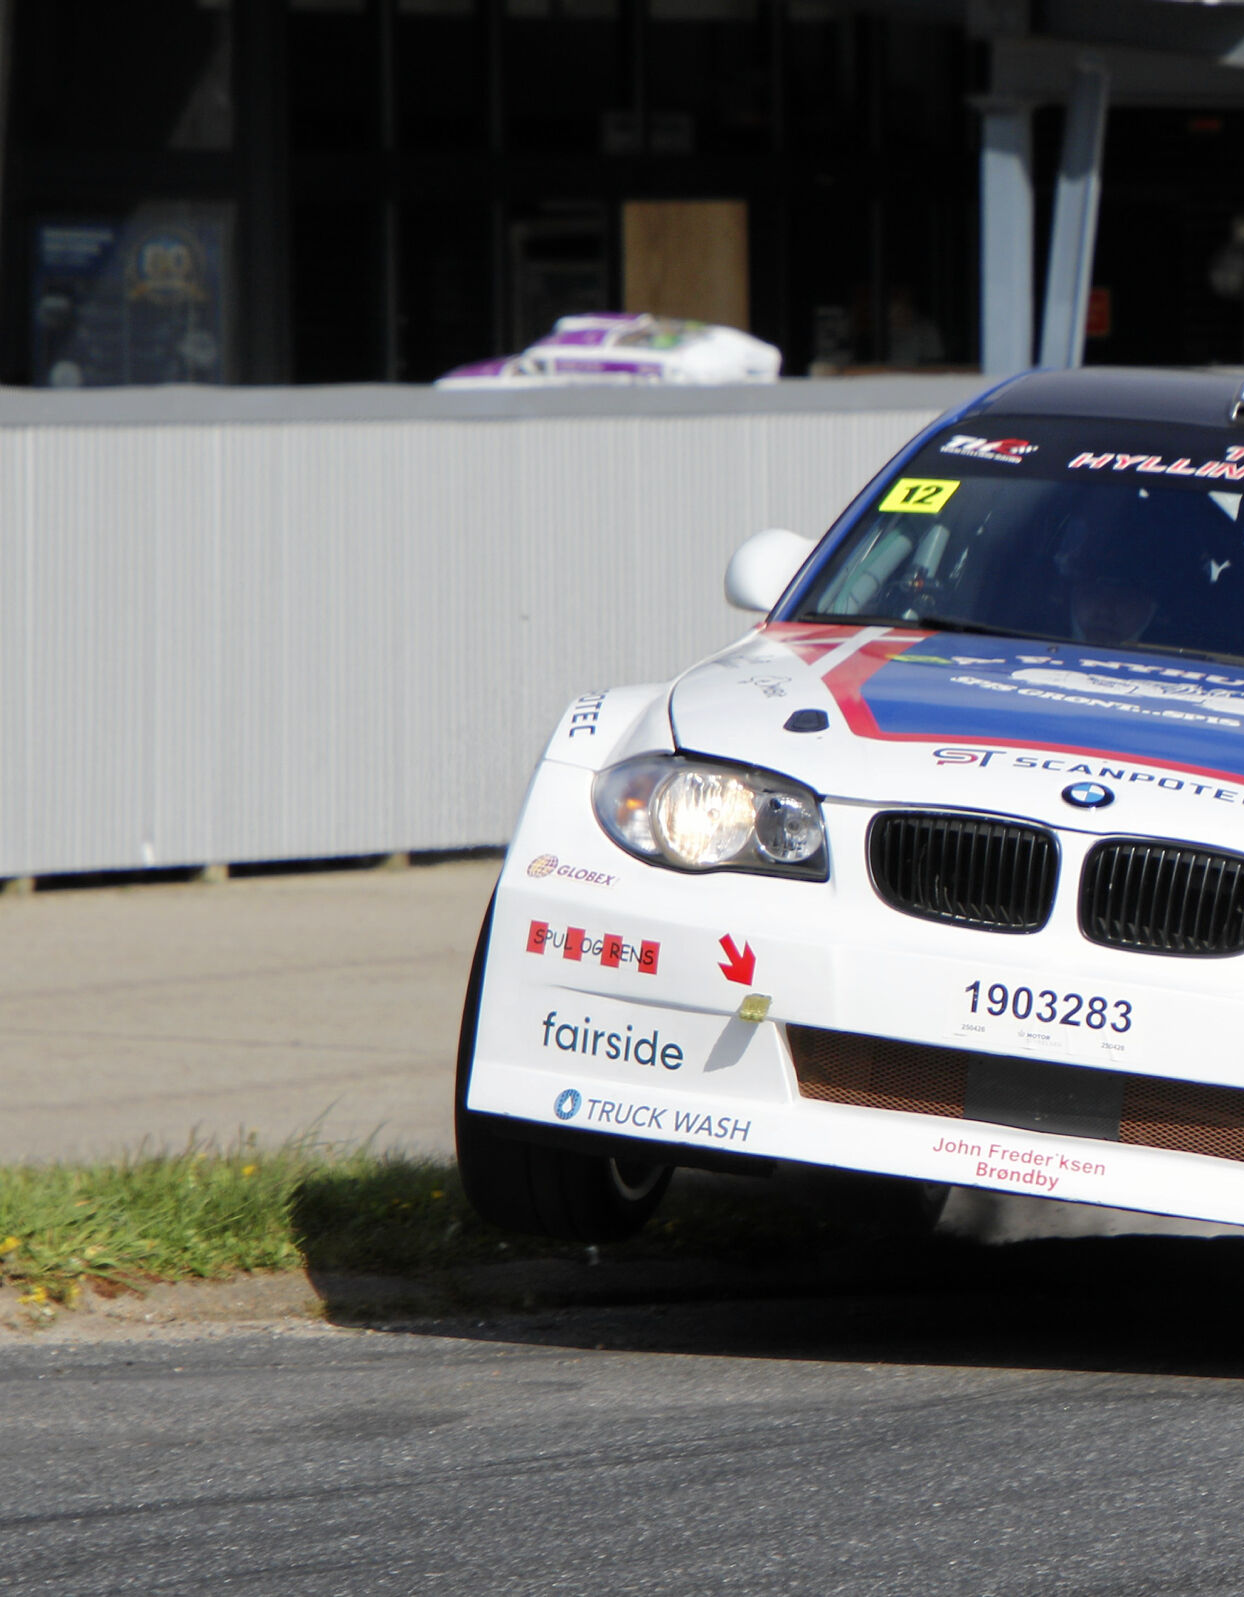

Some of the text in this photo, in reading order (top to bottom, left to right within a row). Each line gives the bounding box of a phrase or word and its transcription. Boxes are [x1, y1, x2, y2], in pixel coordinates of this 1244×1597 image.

[899, 484, 945, 506] 12
[556, 863, 617, 886] GLOBEX
[533, 928, 655, 966] SPUL OG RENS
[964, 979, 1133, 1034] 1903283
[541, 1011, 684, 1070] fairside
[587, 1099, 752, 1142] TRUCK WASH
[932, 1137, 1107, 1176] John Frederksen
[975, 1161, 1060, 1192] Brøndby
